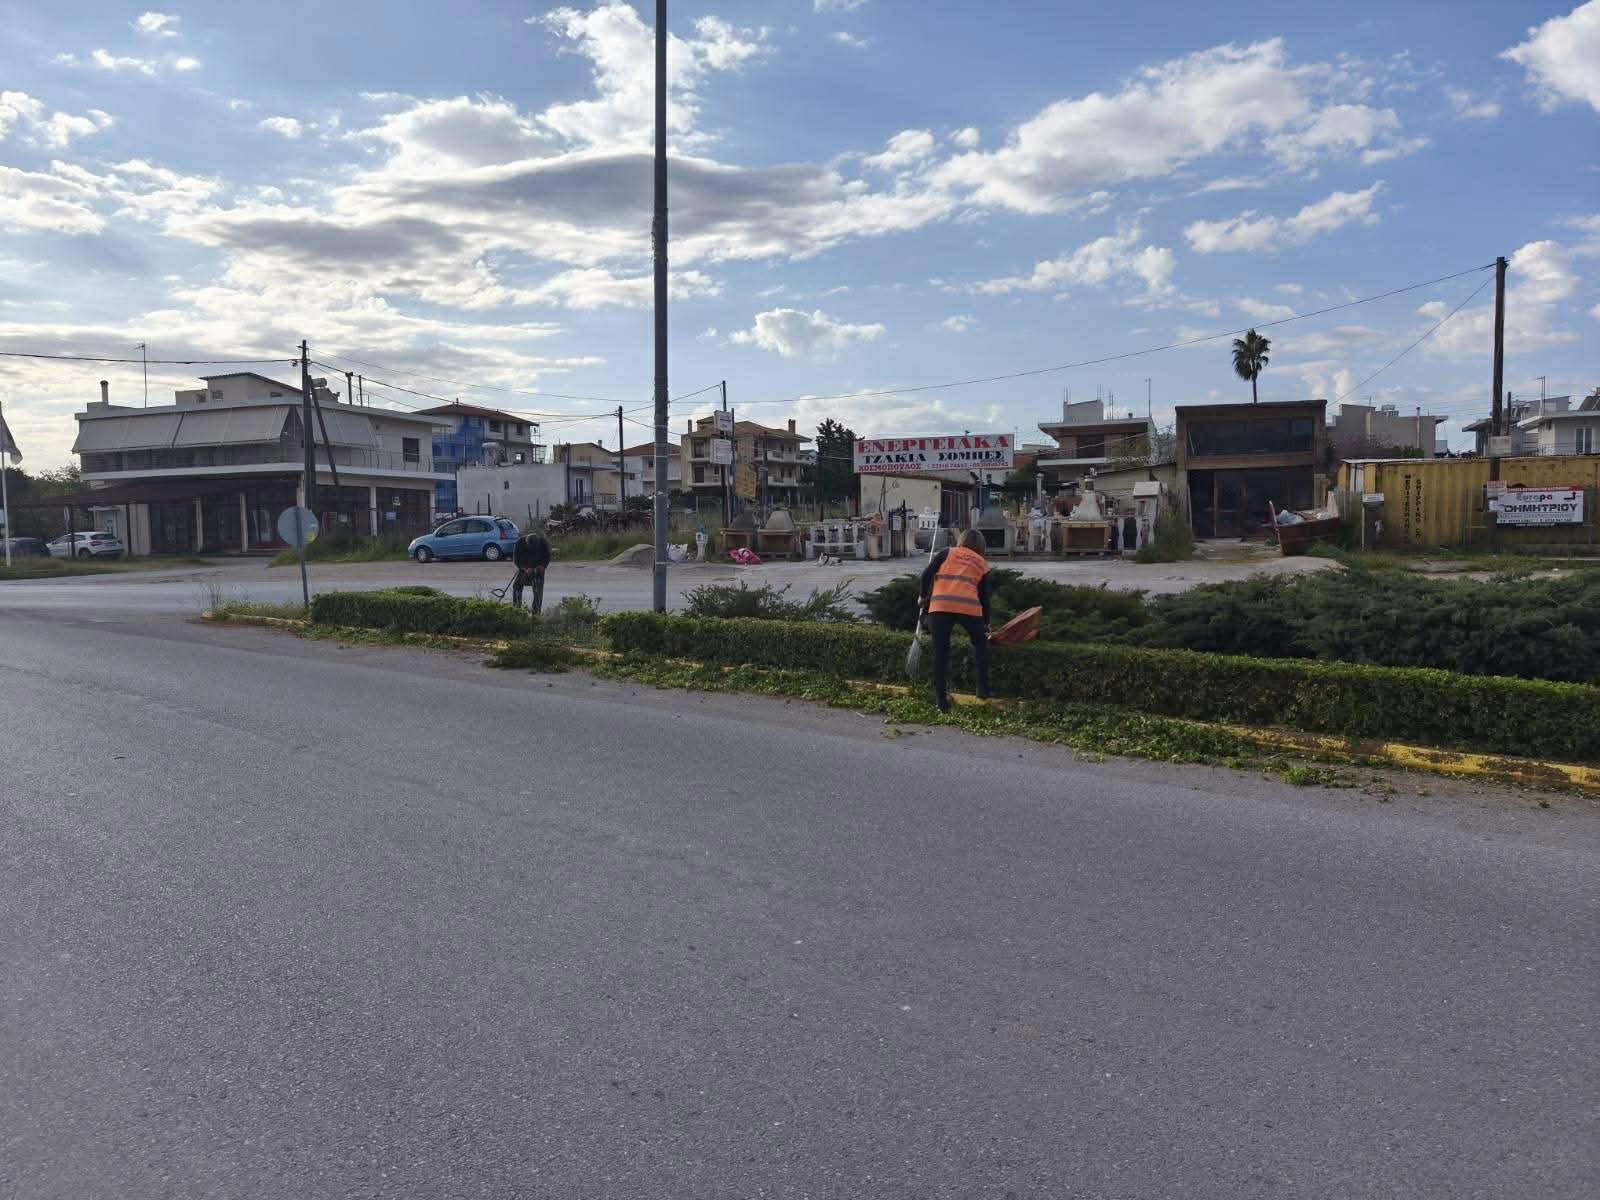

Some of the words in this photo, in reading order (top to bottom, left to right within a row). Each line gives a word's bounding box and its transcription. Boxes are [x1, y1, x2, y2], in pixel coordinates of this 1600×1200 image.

[857, 436, 1009, 453] ΕΝΕΡΓΕΙΑΚΑ
[863, 452, 927, 464] ΤΖΑΚΙΑ
[938, 450, 1004, 462] ΣΟΜΠΕΣ
